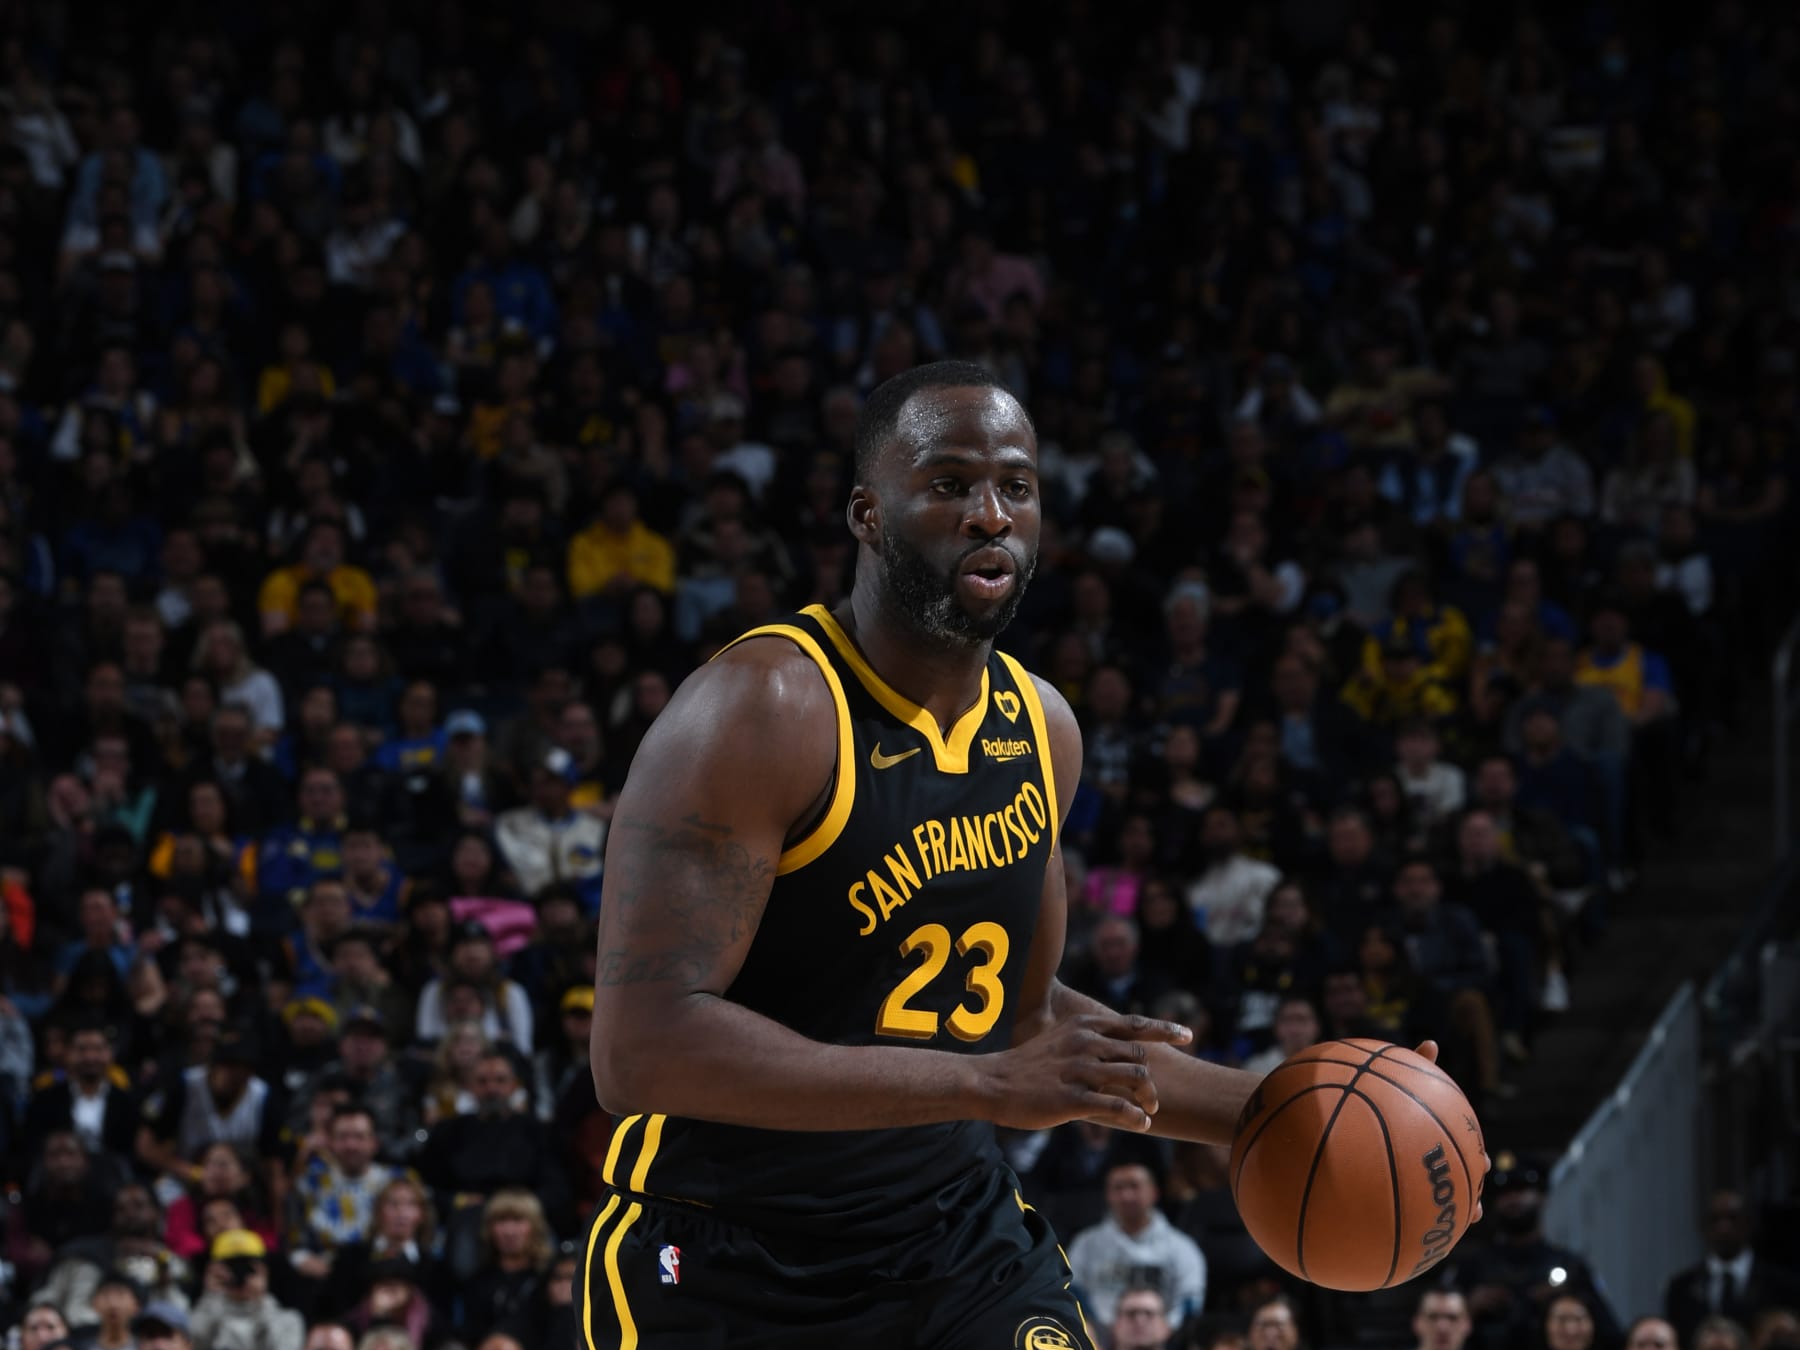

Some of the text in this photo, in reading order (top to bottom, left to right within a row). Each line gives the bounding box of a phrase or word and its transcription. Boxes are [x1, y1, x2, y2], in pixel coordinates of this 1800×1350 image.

[980, 736, 1033, 758] Rakuten
[848, 780, 1047, 937] SAN FRANCISCO
[874, 921, 1011, 1043] 23
